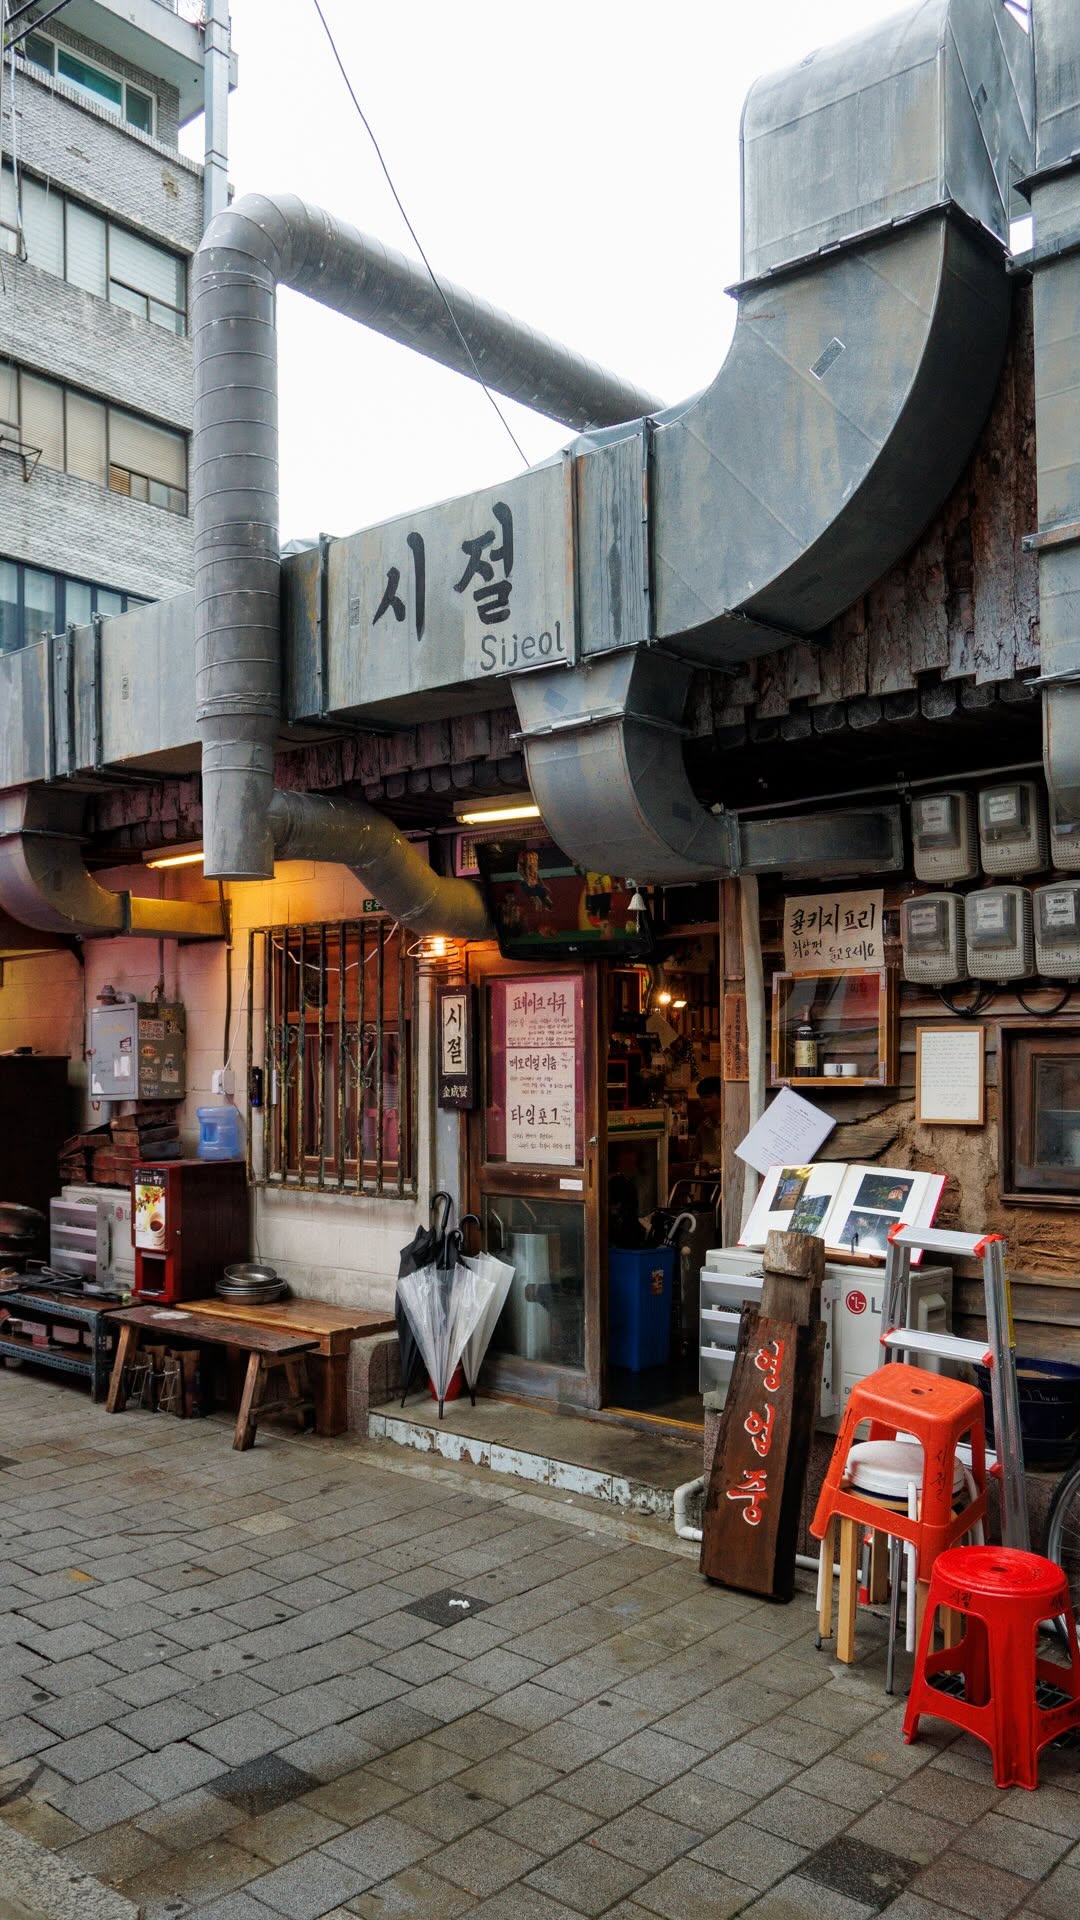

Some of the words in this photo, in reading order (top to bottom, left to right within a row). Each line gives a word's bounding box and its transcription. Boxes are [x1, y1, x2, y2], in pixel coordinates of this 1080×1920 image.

[372, 501, 514, 642] 시절
[480, 620, 565, 672] Sijeol
[843, 903, 876, 932] 프리
